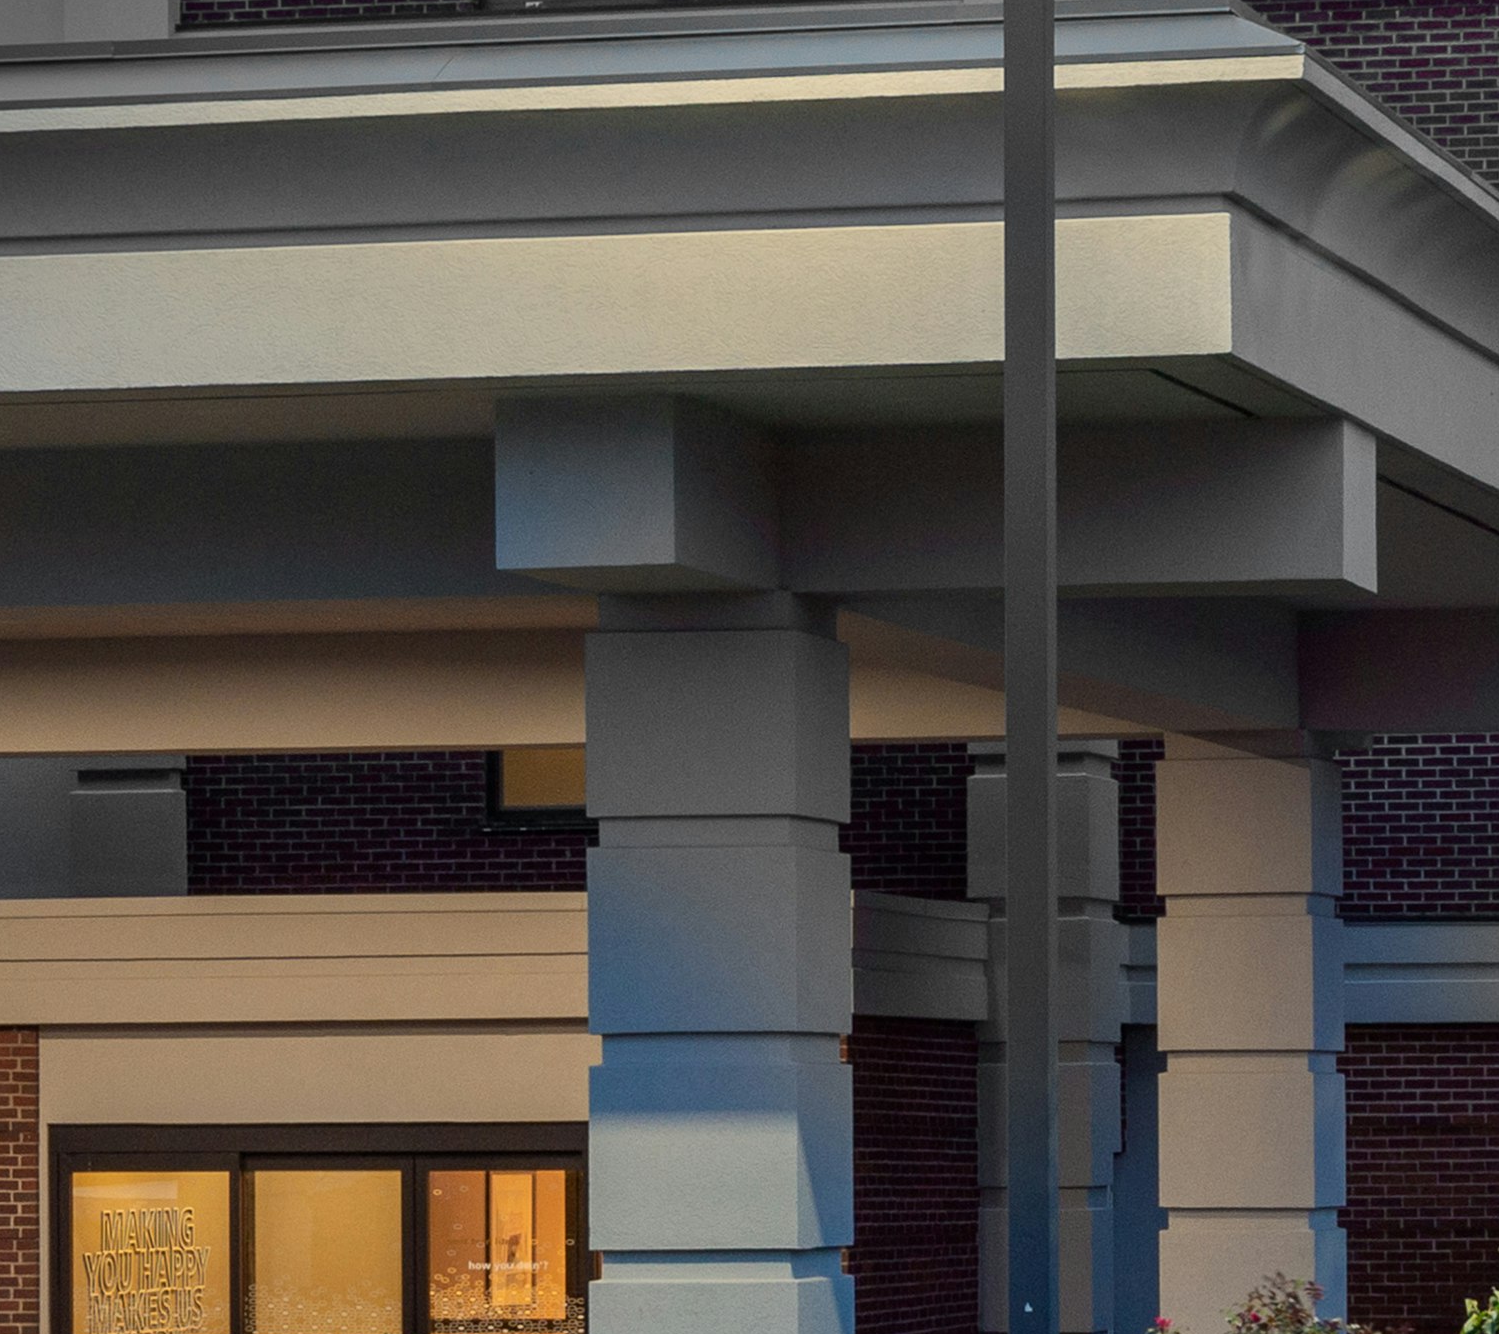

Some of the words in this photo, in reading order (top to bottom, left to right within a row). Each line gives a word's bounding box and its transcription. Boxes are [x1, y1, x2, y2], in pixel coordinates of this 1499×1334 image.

[101, 1207, 195, 1251] MAKING
[83, 1251, 133, 1294] YOU
[137, 1246, 211, 1289] HAPPY
[468, 1260, 491, 1270] how
[493, 1262, 514, 1272] you
[90, 1288, 171, 1334] MAKES
[175, 1286, 204, 1330] US
